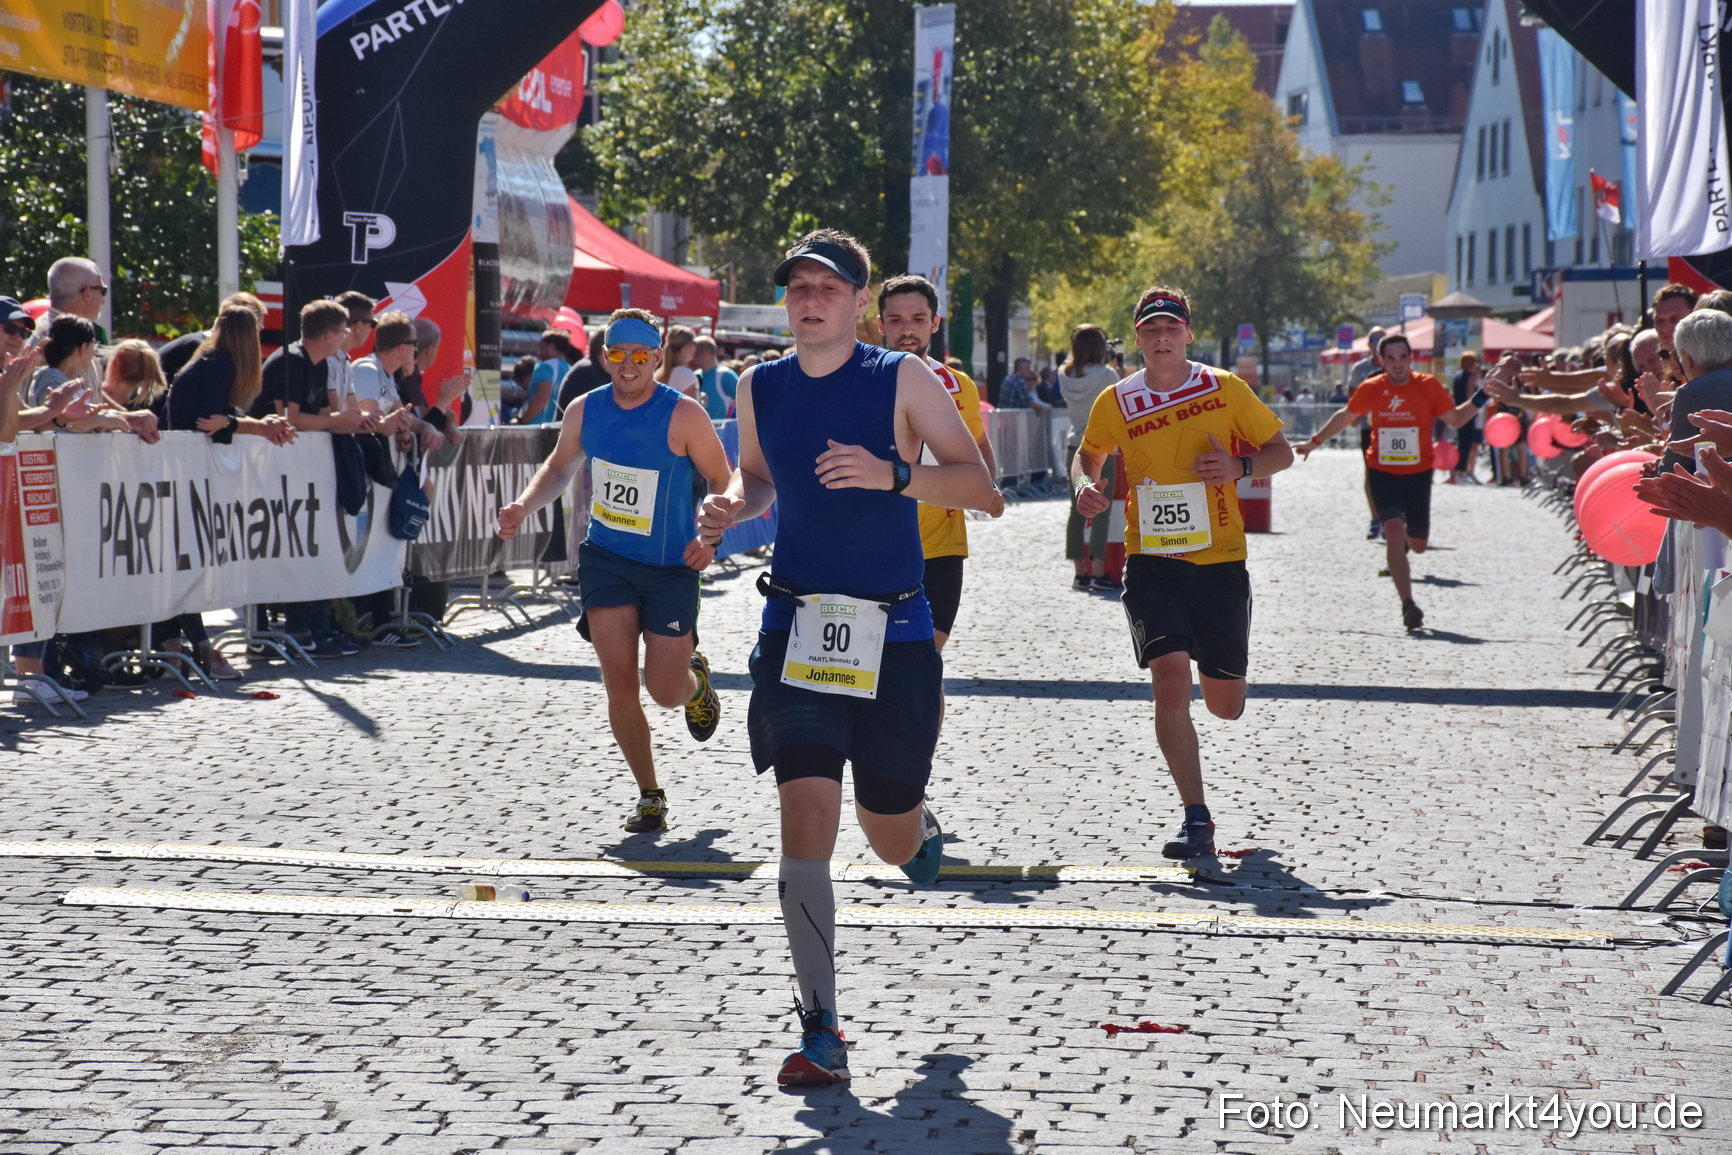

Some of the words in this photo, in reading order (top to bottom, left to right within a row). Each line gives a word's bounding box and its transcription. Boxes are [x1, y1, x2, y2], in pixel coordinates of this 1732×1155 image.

[349, 0, 451, 61] PARTL
[1127, 414, 1171, 441] MAX
[1175, 397, 1227, 422] BÖGL
[1391, 439, 1406, 450] 80
[607, 469, 638, 482] BOCK
[603, 481, 639, 506] 120
[1153, 490, 1185, 499] BOCK
[602, 510, 637, 527] Johannes
[1151, 502, 1190, 525] 255
[98, 480, 192, 579] PARTL
[1160, 537, 1188, 546] Simon
[820, 603, 858, 617] BOCK
[822, 622, 851, 653] 90
[808, 655, 828, 663] PARTL
[829, 656, 852, 665] Neumarkt
[806, 668, 856, 685] Johannes
